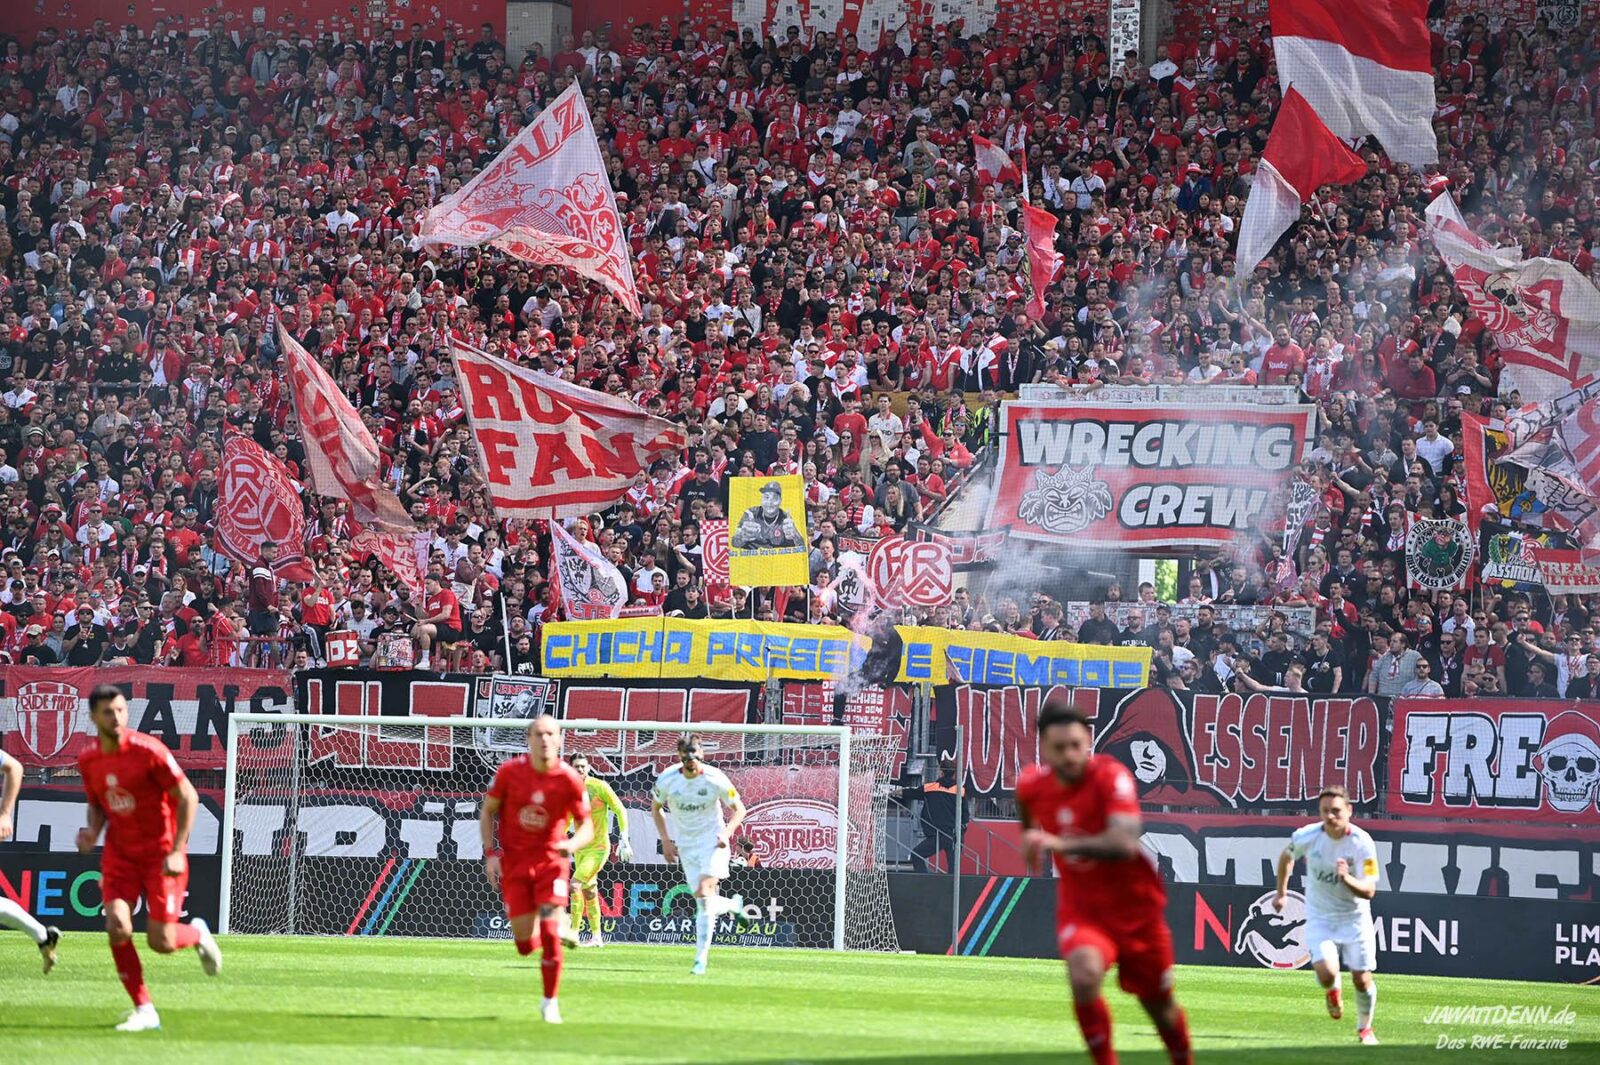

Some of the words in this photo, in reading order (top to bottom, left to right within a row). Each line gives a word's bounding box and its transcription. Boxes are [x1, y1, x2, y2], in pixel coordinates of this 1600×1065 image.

[1018, 421, 1294, 470] WRECKING
[1119, 484, 1268, 529] CREW
[545, 630, 691, 669] CHICHA
[1191, 694, 1380, 804] ESSENER
[1555, 923, 1600, 944] LIM
